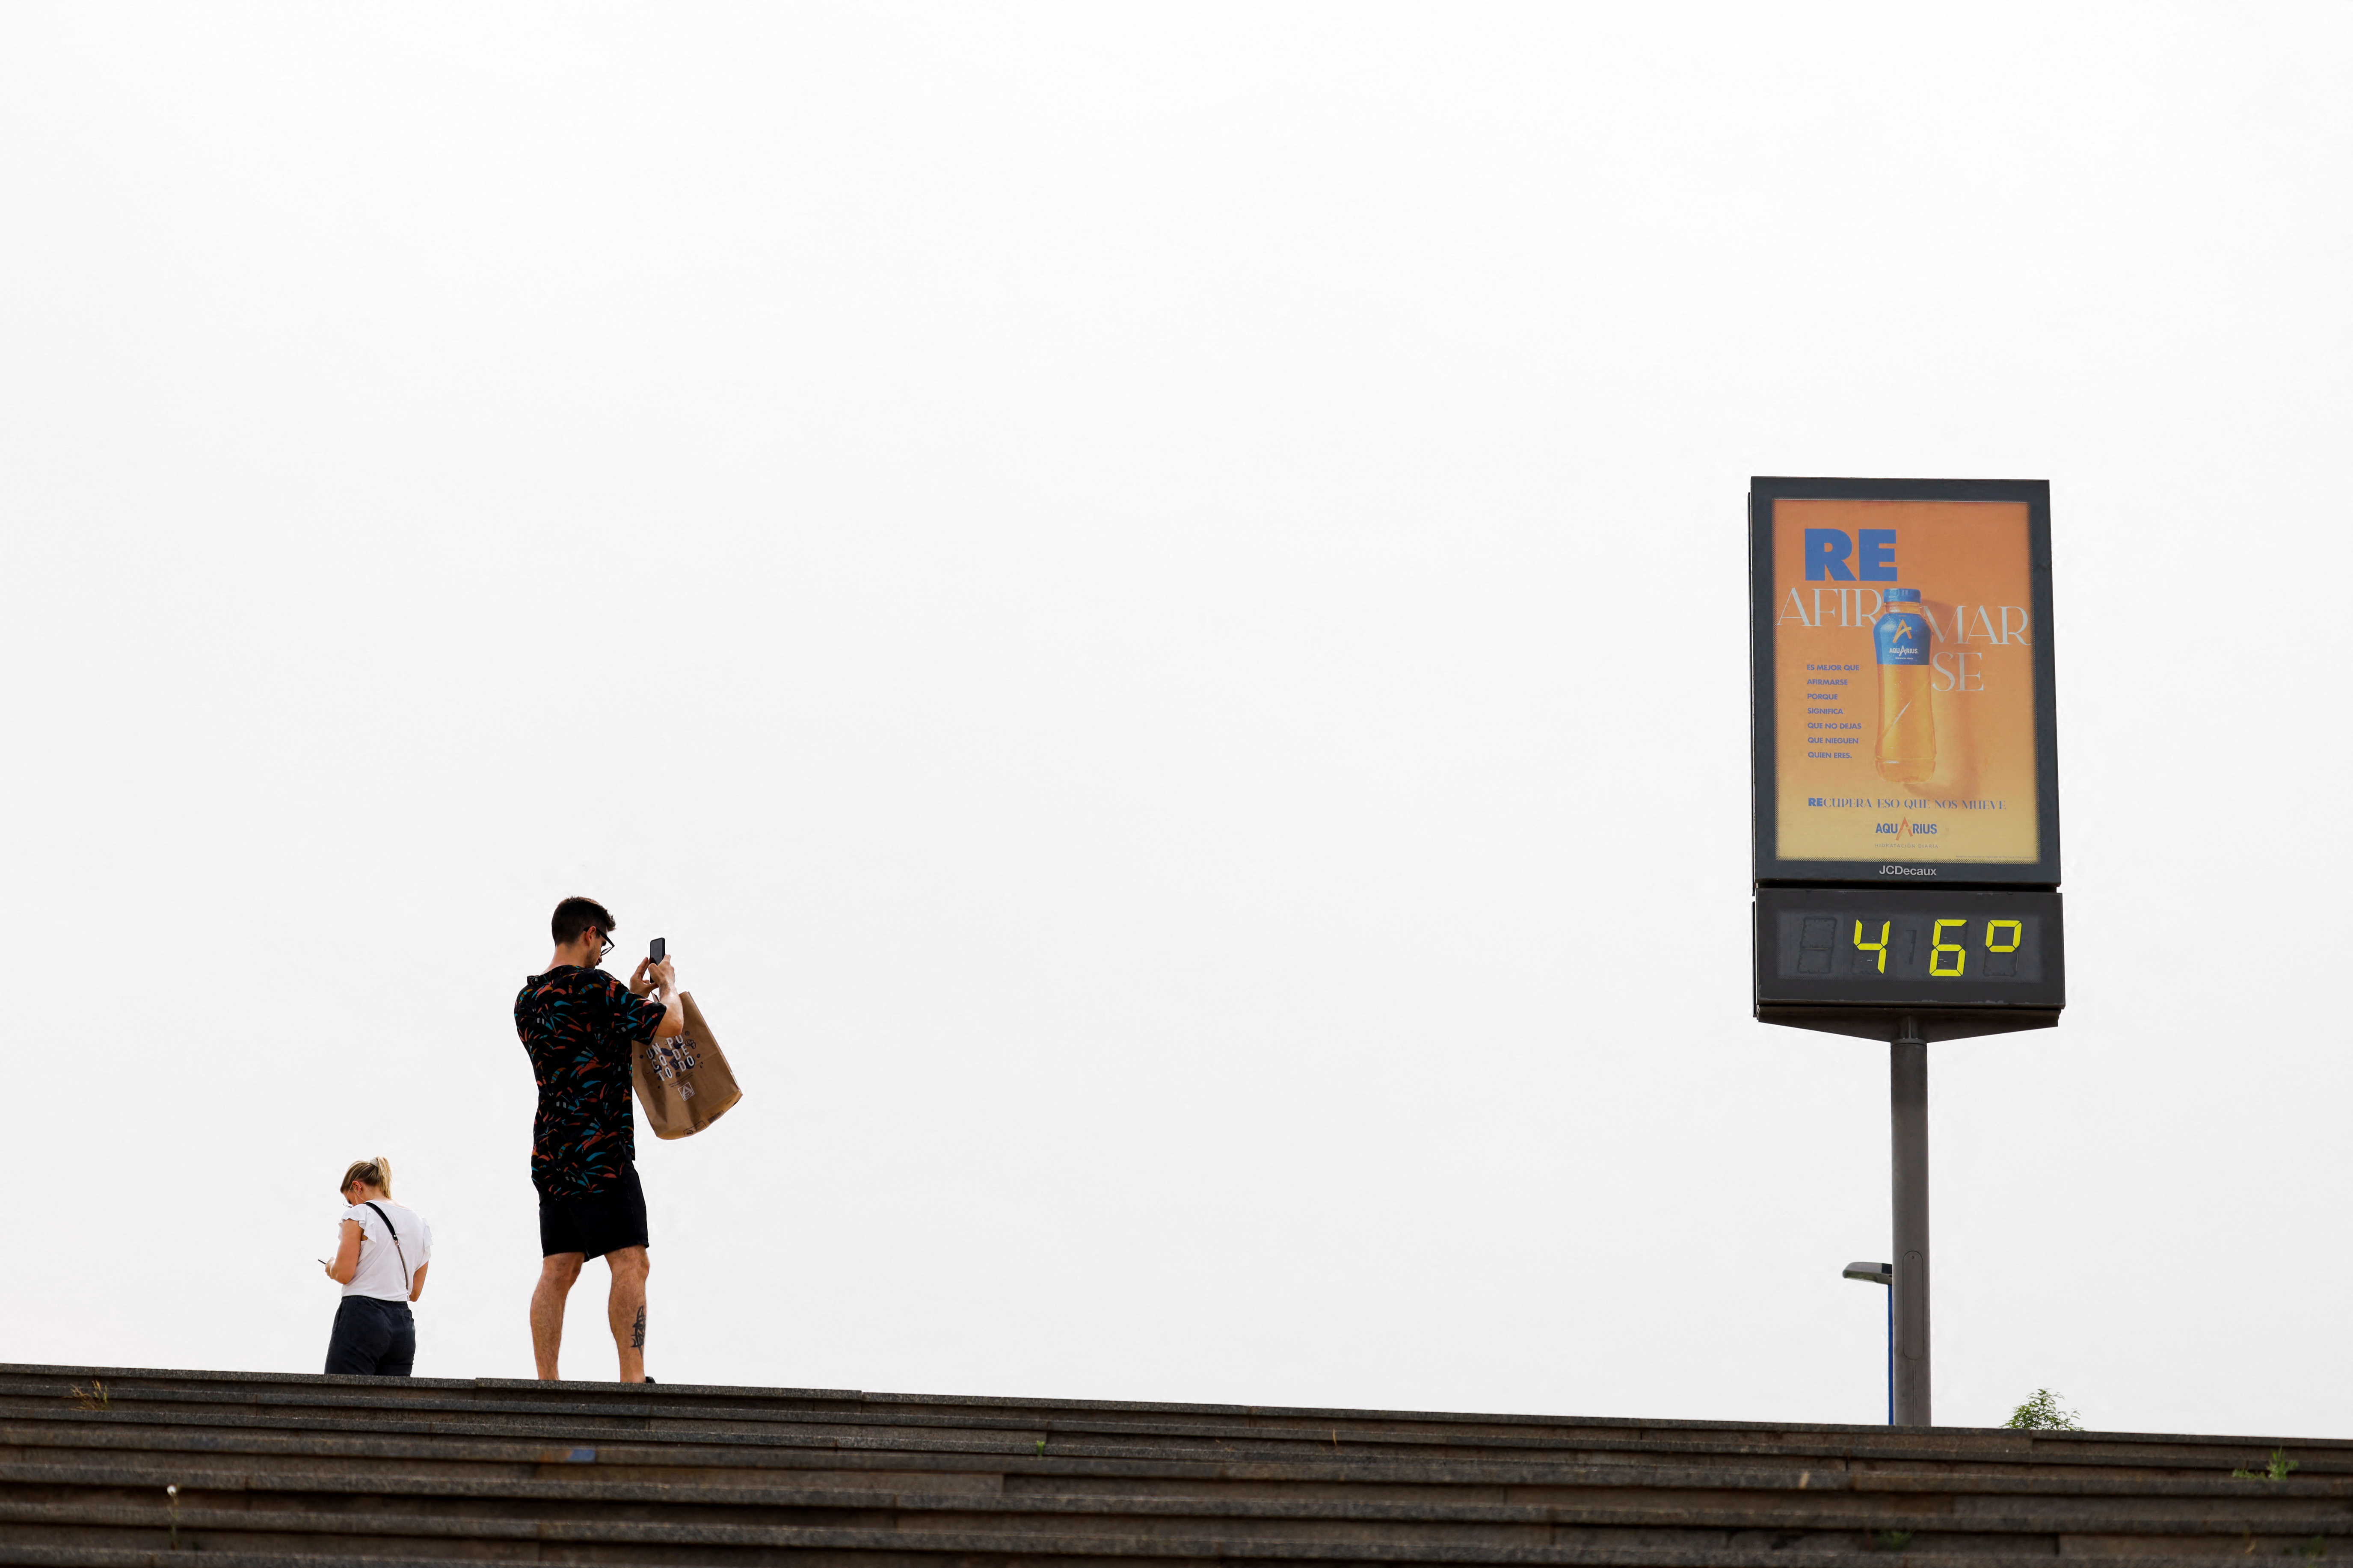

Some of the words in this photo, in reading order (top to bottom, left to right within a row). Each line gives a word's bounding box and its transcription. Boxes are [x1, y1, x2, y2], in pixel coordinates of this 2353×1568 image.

[1805, 529, 1898, 581] RE
[1777, 587, 1882, 627] AFIR
[1920, 605, 2031, 645] MAR
[1889, 645, 1918, 657] AQUARIUS
[1932, 652, 1984, 692] SE
[1808, 798, 1872, 808] RECUPERA
[1878, 799, 1900, 808] ESO
[1904, 799, 1930, 810] QUE
[1935, 800, 1958, 809] NOS
[1962, 800, 2006, 810] MUEVE
[1875, 817, 1938, 841] AQUARIUS
[1879, 865, 1937, 876] JCDecaux
[646, 1042, 662, 1059] UN
[652, 1055, 667, 1070] CO
[672, 1044, 689, 1061] DE
[656, 1067, 673, 1081] TO
[678, 1056, 694, 1072] DO
